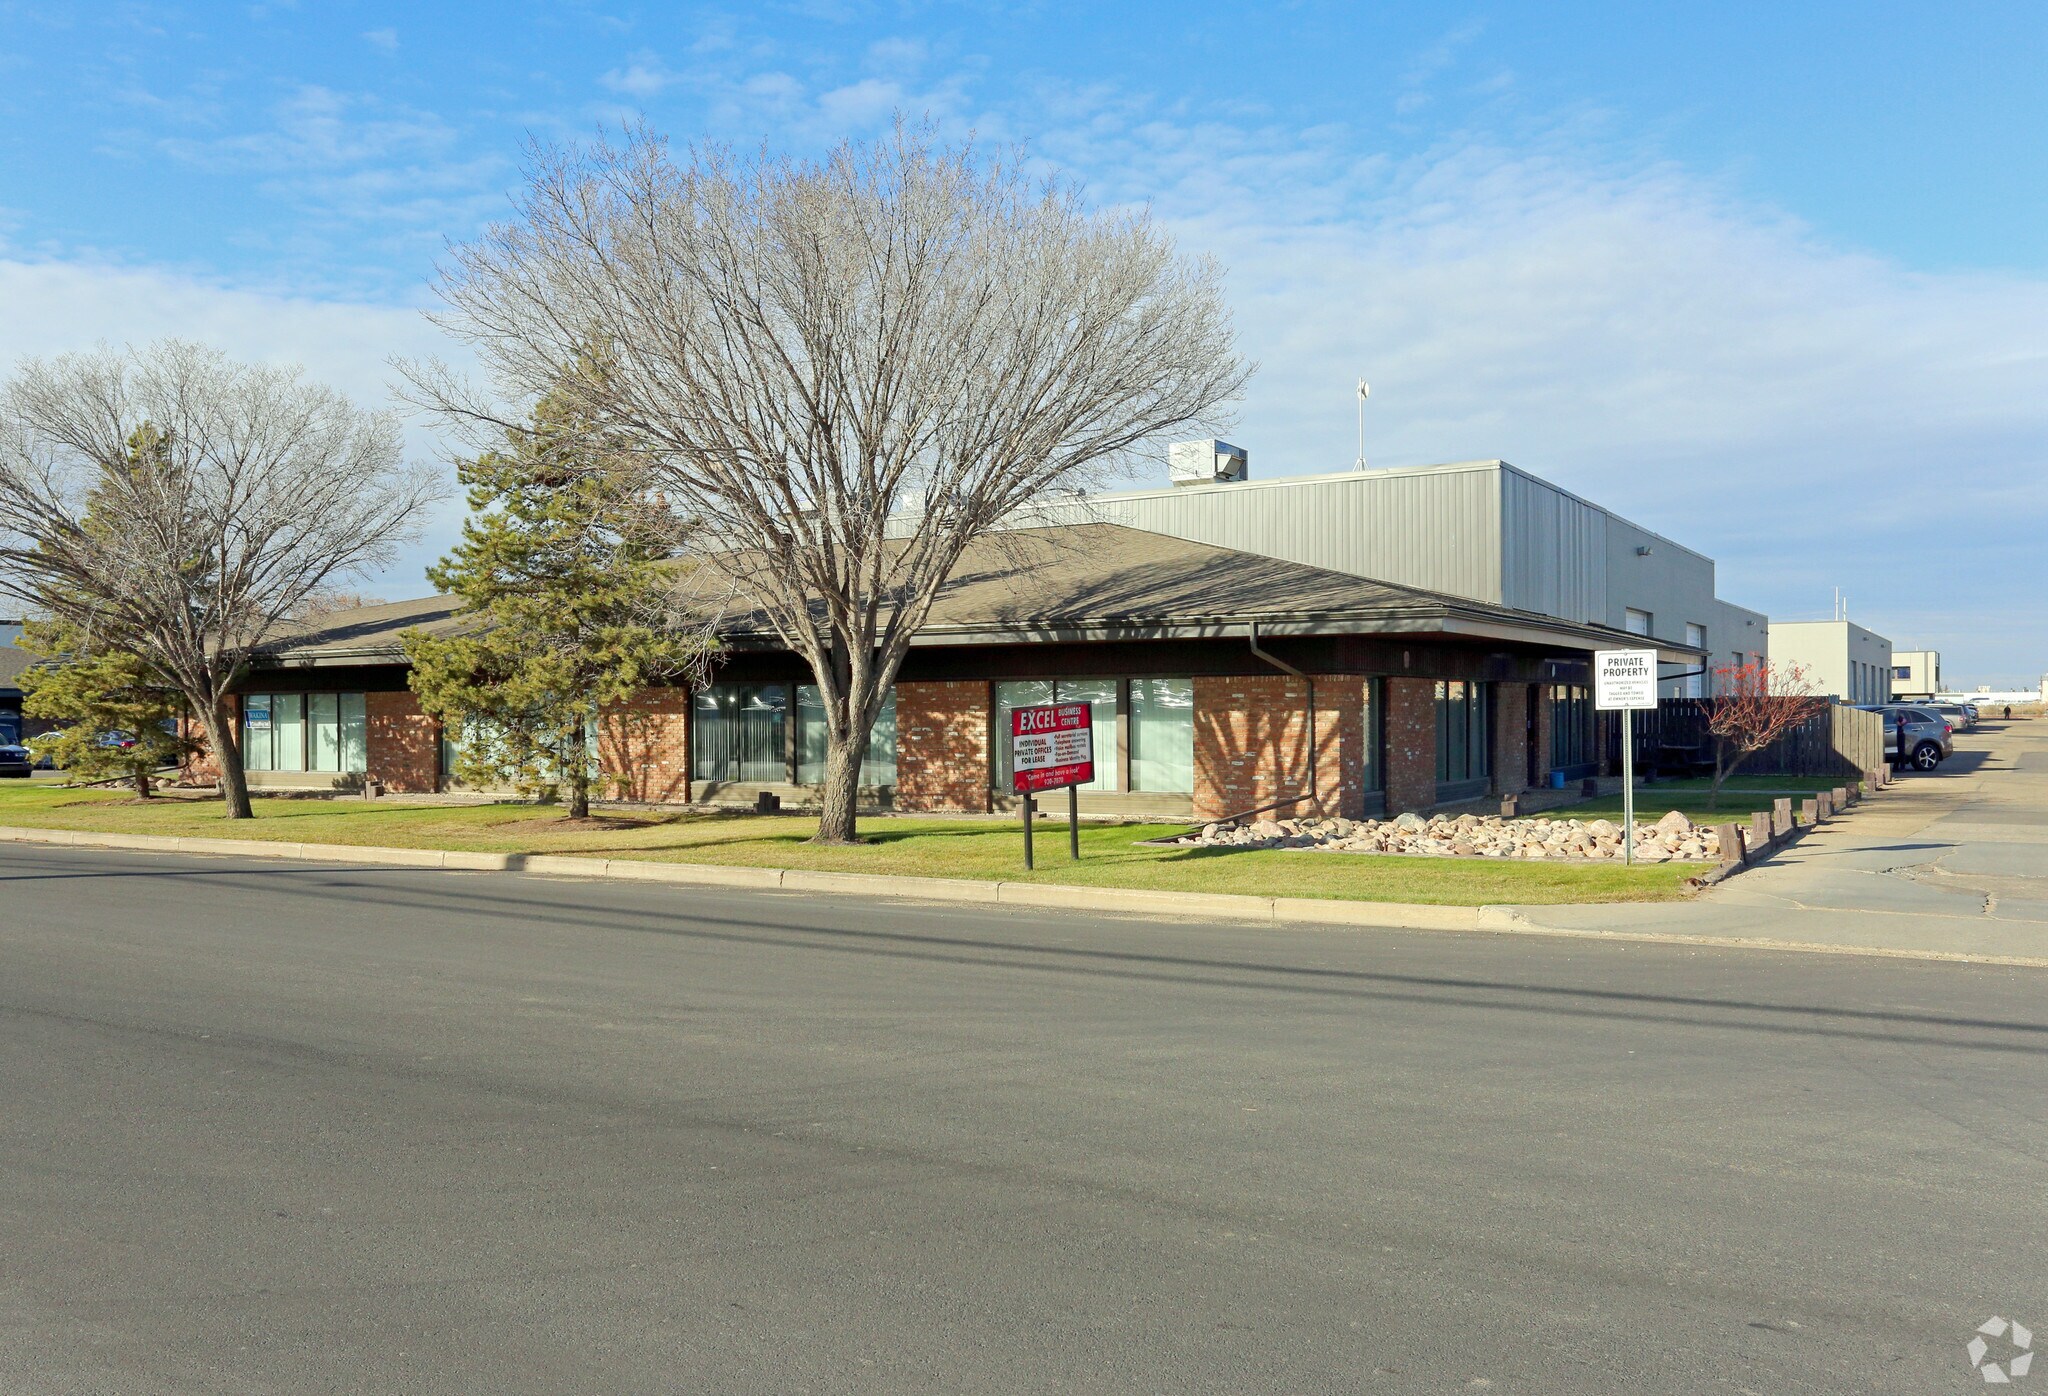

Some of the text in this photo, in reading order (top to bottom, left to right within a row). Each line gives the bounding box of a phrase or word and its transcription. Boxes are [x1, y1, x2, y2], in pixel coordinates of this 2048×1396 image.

[1608, 658, 1643, 666] PRIVATE
[1604, 668, 1648, 676] PROPERTY
[1020, 706, 1081, 730] EXCEL BUSINESS
[1061, 717, 1079, 726] CENTRE
[1019, 739, 1046, 748] INDIVIDUAL
[1015, 746, 1052, 757] PRIVATE OFFICES
